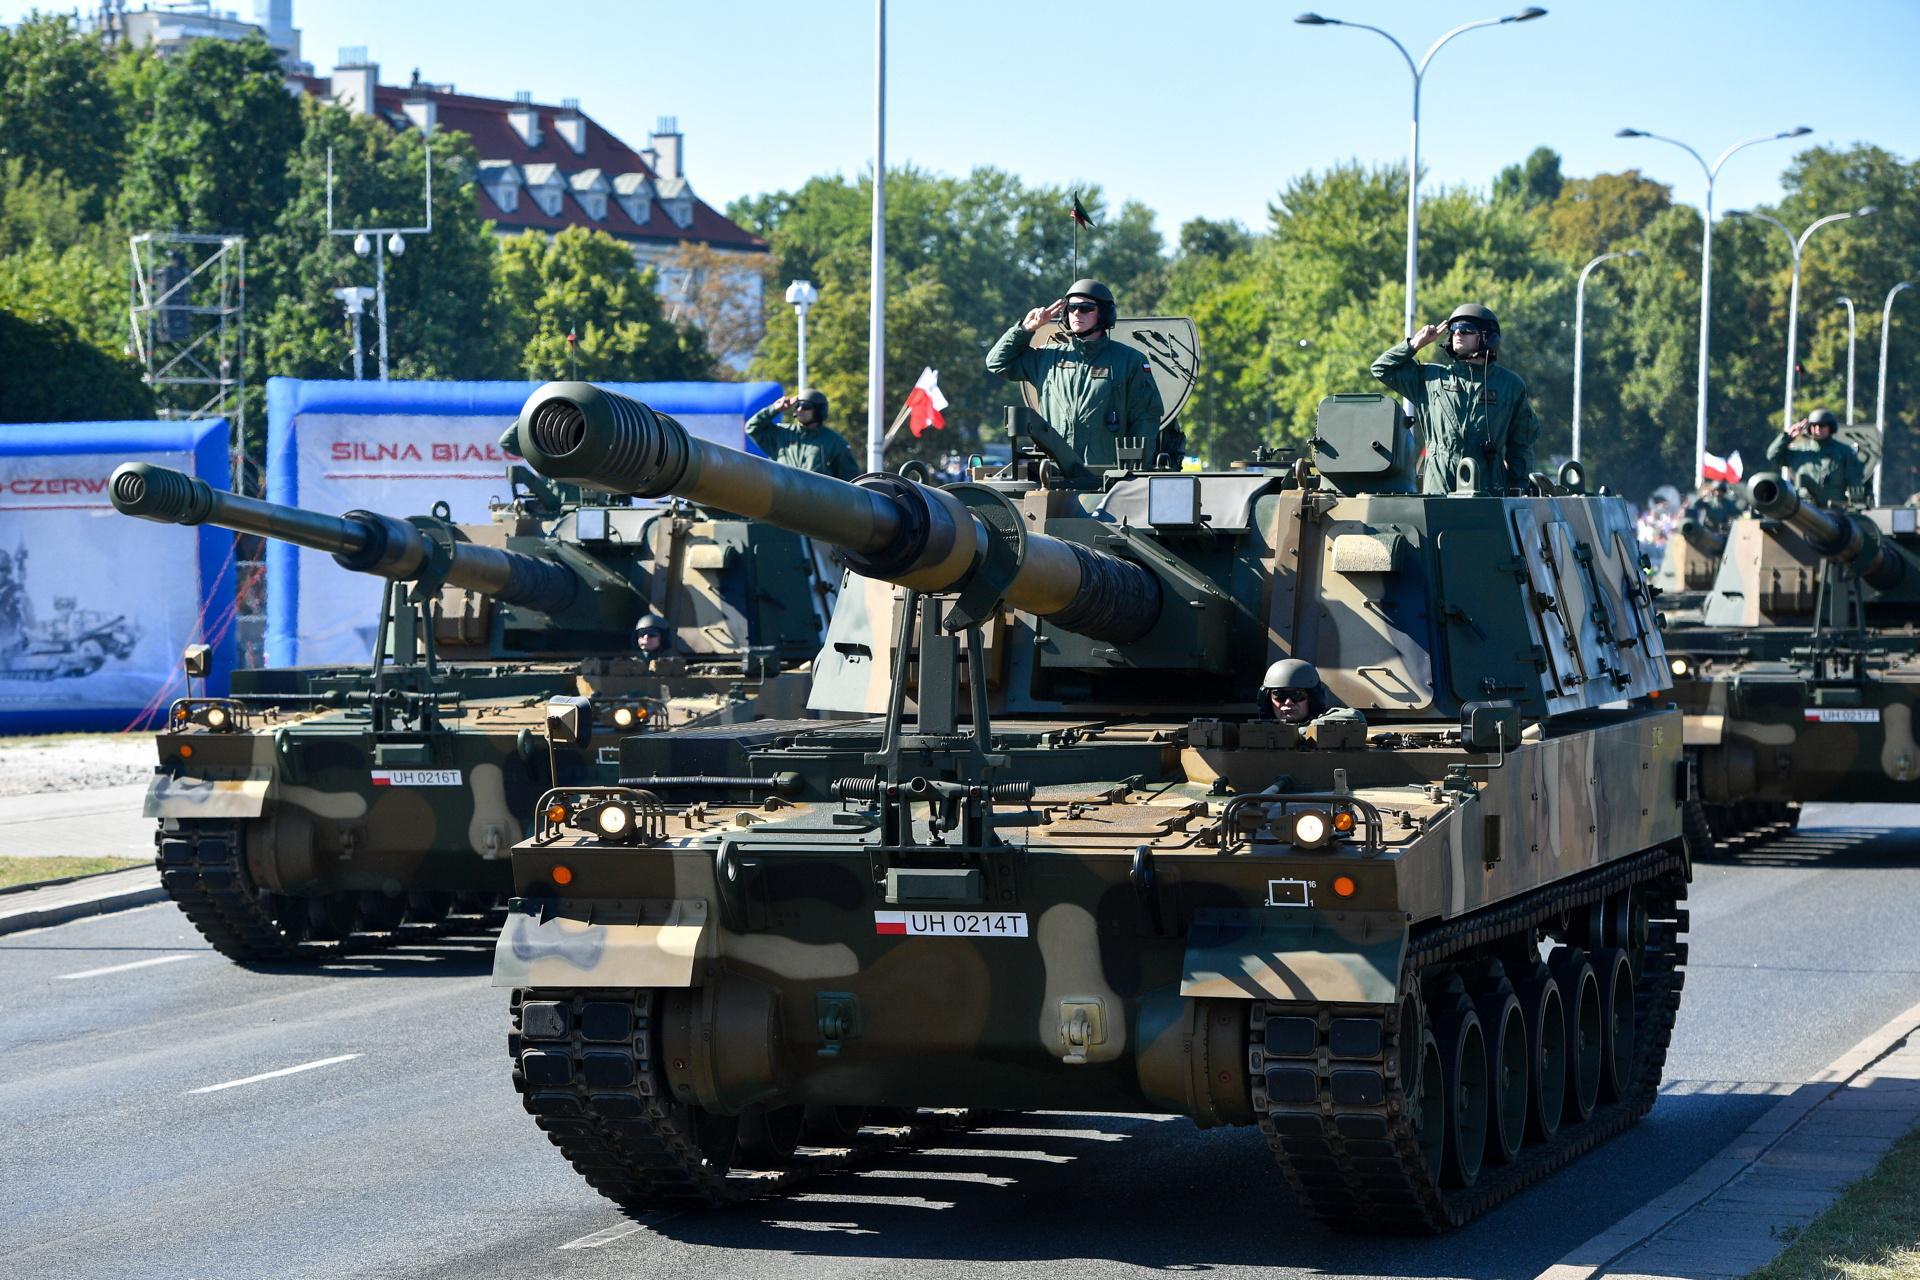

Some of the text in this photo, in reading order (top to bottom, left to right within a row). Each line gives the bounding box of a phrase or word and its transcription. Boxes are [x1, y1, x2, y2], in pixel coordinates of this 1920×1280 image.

[331, 442, 422, 462] SILNA
[393, 772, 458, 784] UH 0216T
[1264, 898, 1270, 907] 2
[912, 914, 1022, 934] UH 0214T
